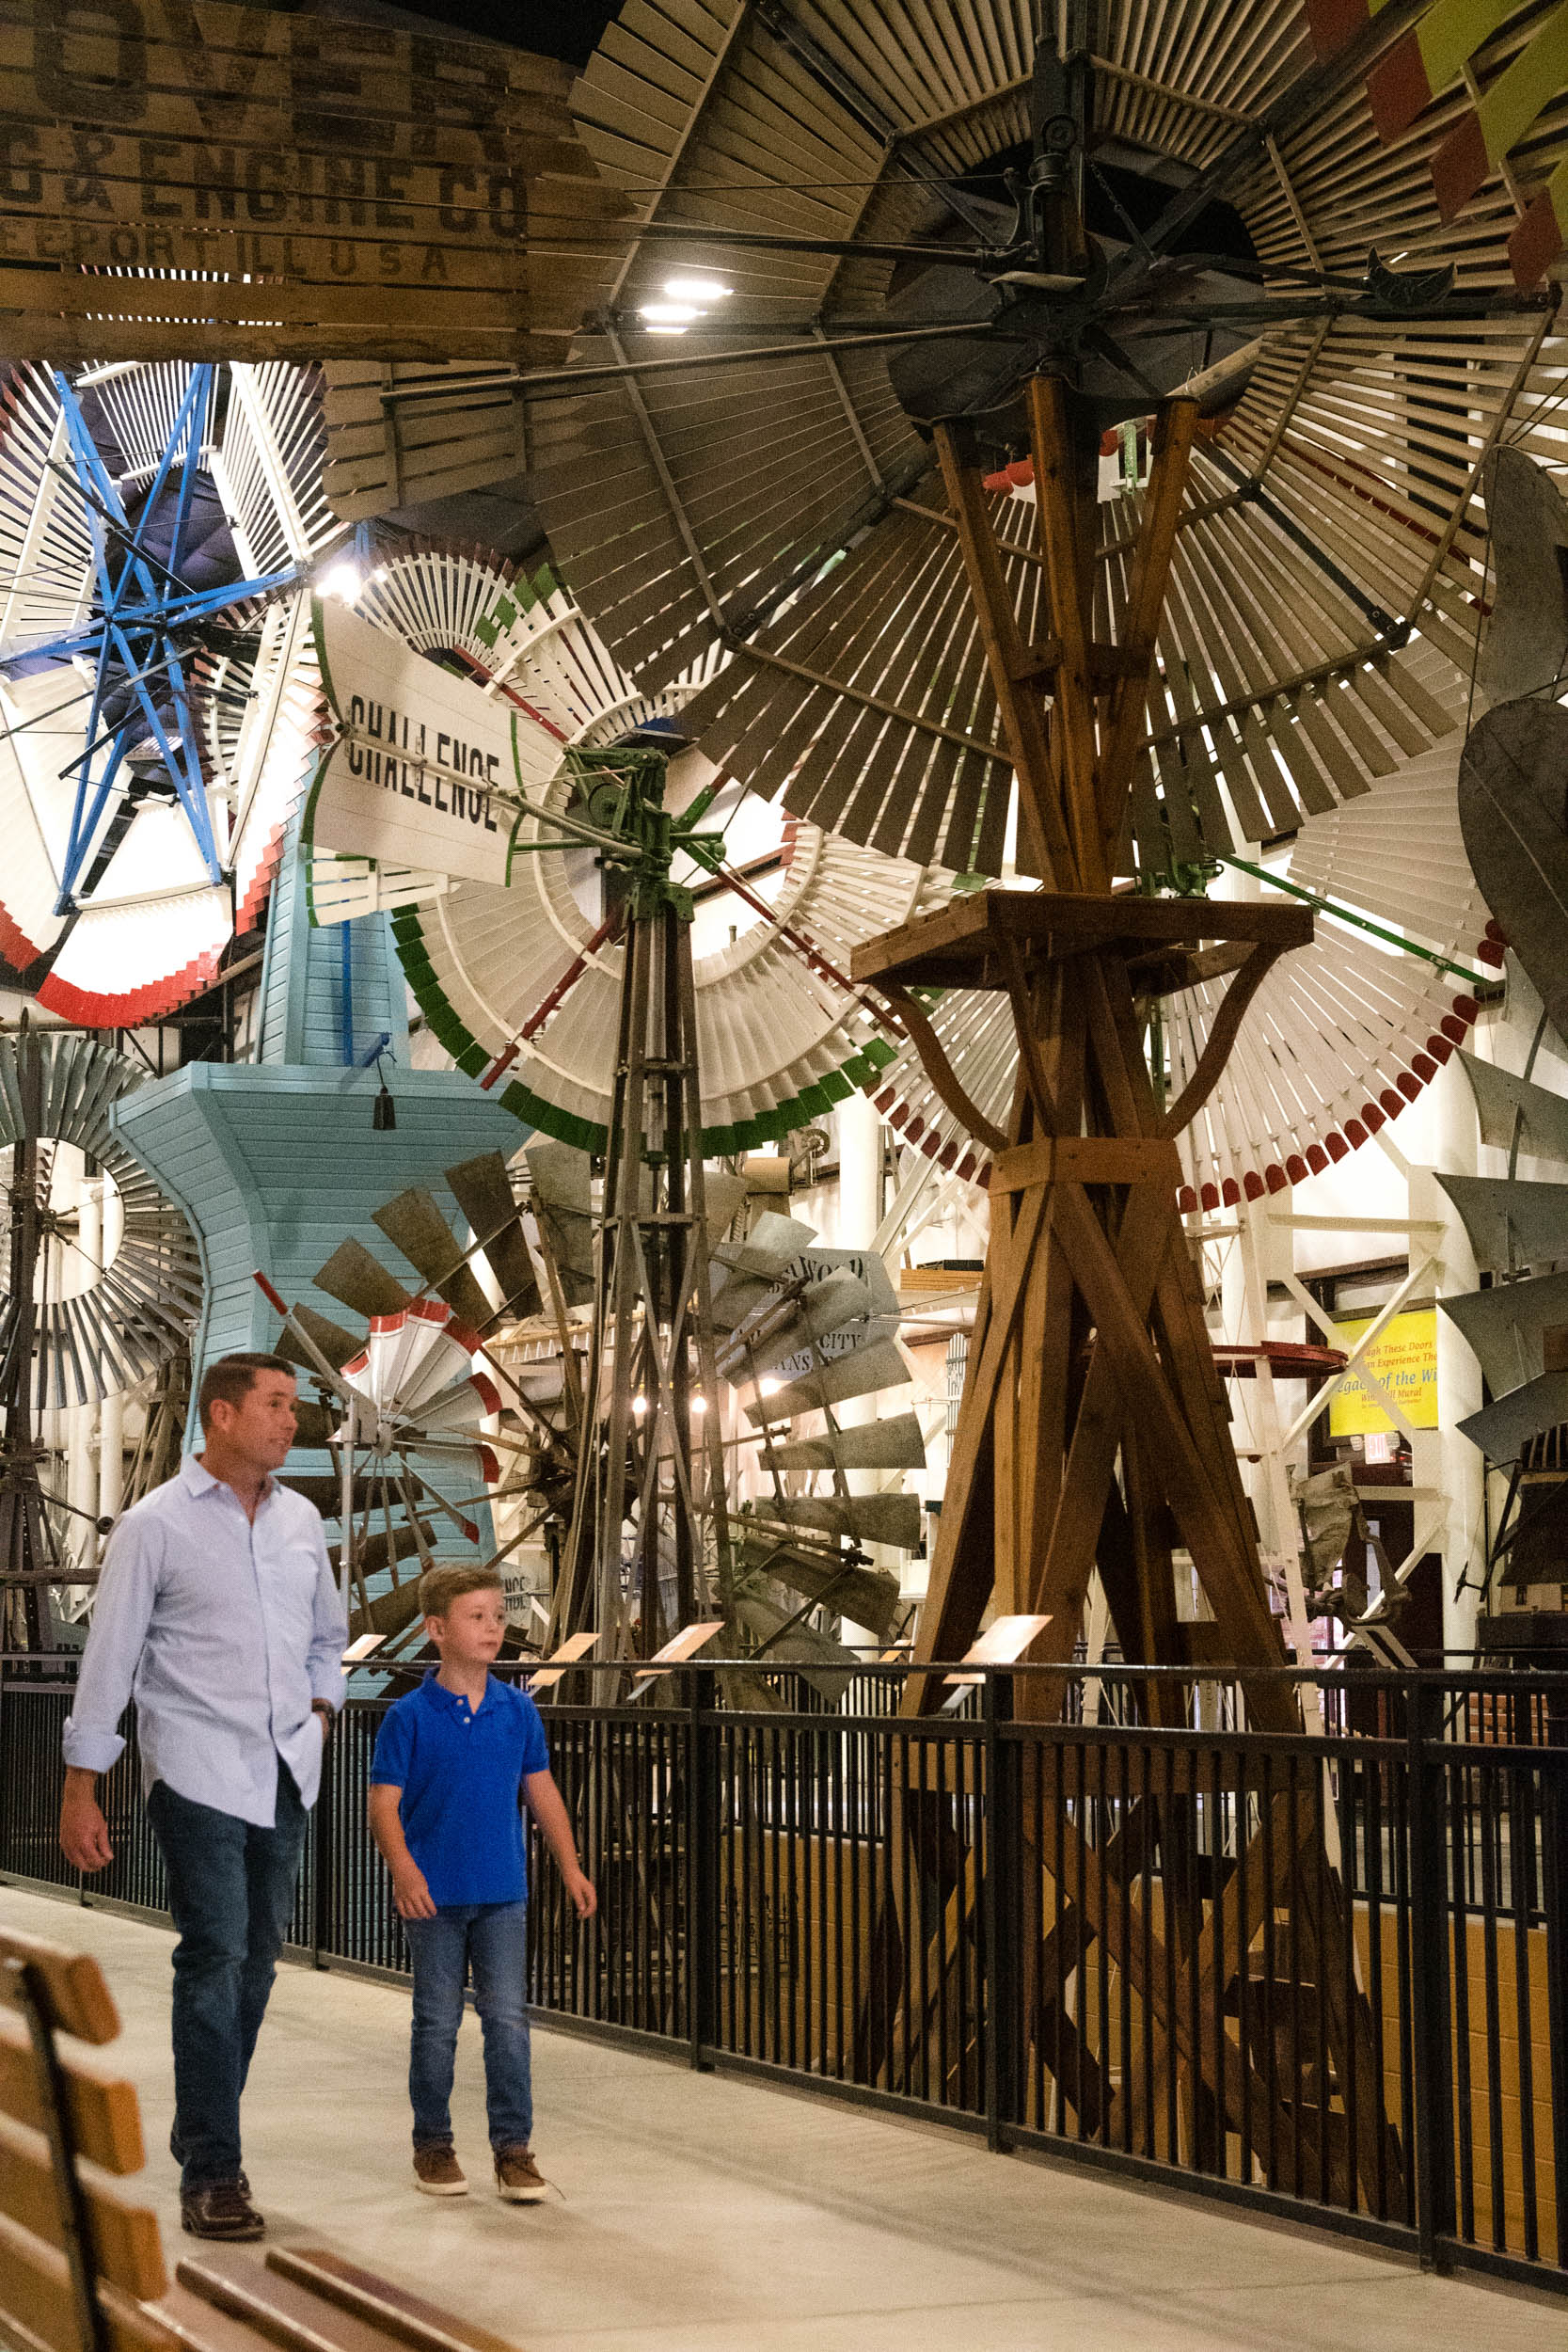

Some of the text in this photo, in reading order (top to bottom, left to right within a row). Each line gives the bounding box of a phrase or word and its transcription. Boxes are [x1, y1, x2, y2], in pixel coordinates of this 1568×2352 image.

[33, 0, 513, 164] OVER
[64, 132, 115, 213] &
[140, 138, 414, 231] ENGINE
[438, 167, 530, 239] CO
[0, 220, 220, 267] EEPORT
[348, 694, 500, 833] CHALLENGE
[819, 1332, 862, 1351] CITY
[1384, 1344, 1406, 1355] These
[1408, 1341, 1433, 1352] Doors
[1377, 1354, 1420, 1368] Experience
[1379, 1372, 1393, 1391] of
[1396, 1370, 1417, 1386] the
[1421, 1368, 1437, 1383] Wi
[1398, 1386, 1422, 1397] Mural
